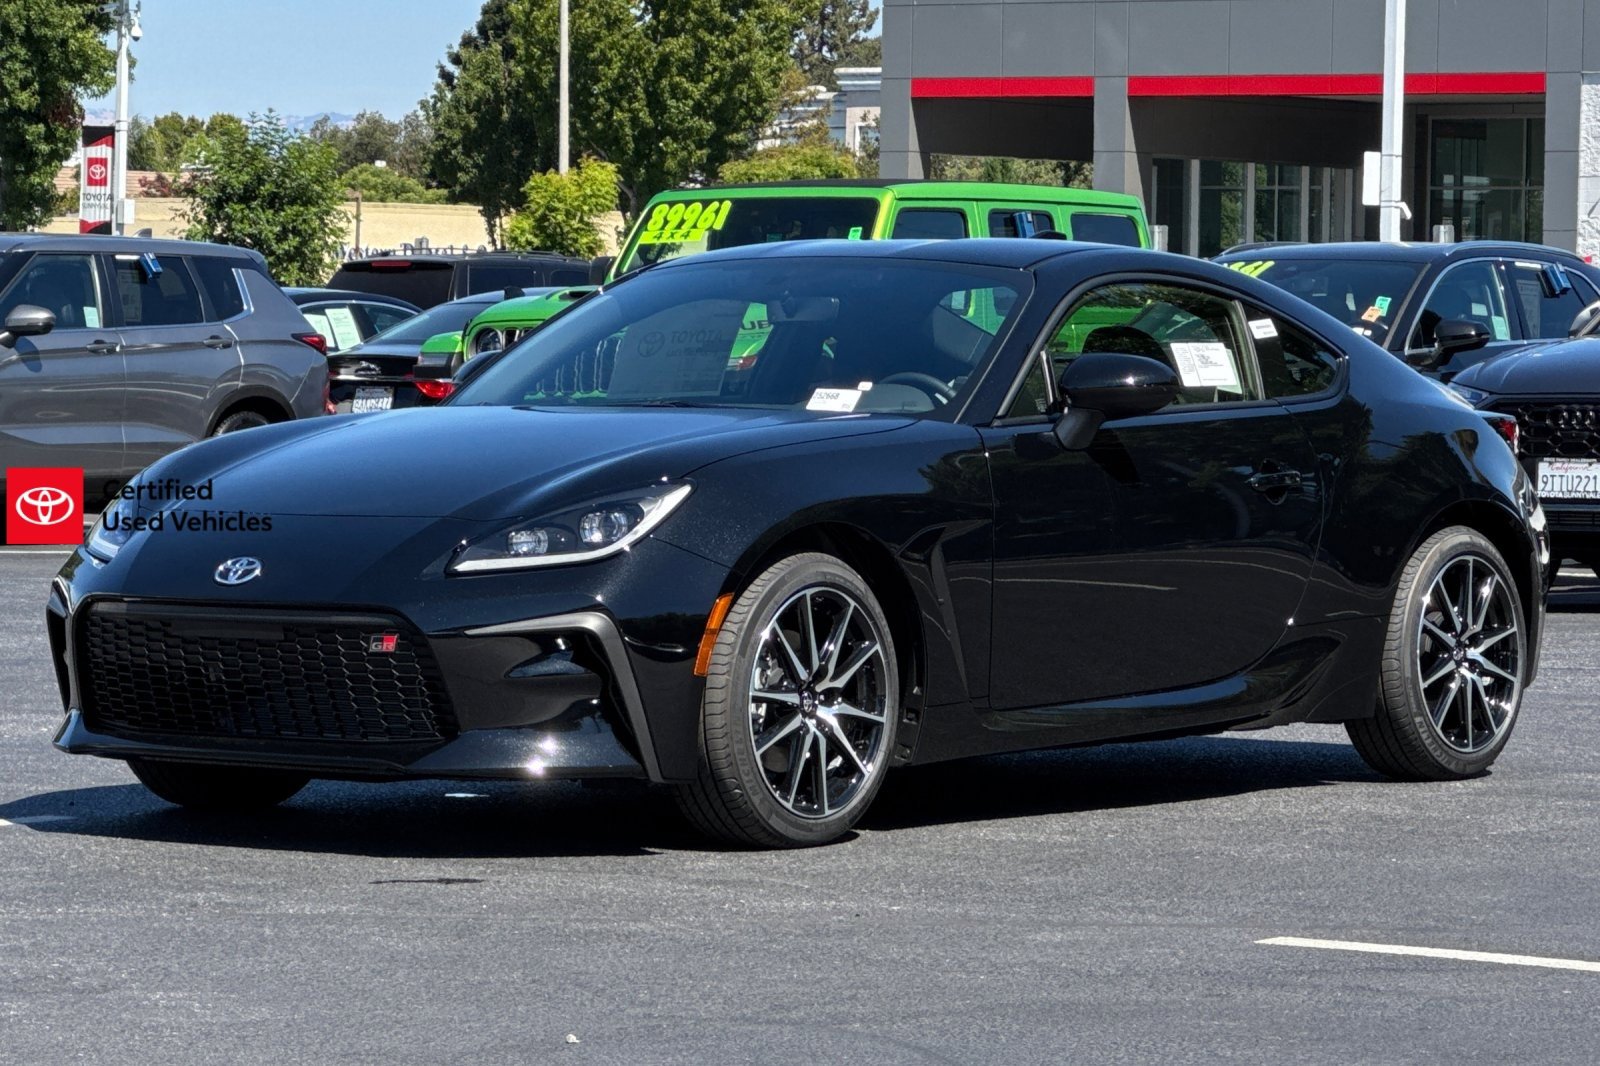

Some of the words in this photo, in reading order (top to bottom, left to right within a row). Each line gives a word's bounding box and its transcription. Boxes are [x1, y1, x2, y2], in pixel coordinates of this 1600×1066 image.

[82, 192, 113, 201] TOYOTA
[647, 200, 732, 231] 89961
[671, 330, 723, 344] TOYOTA
[1541, 474, 1599, 492] 9TTU221
[371, 641, 395, 650] GR
